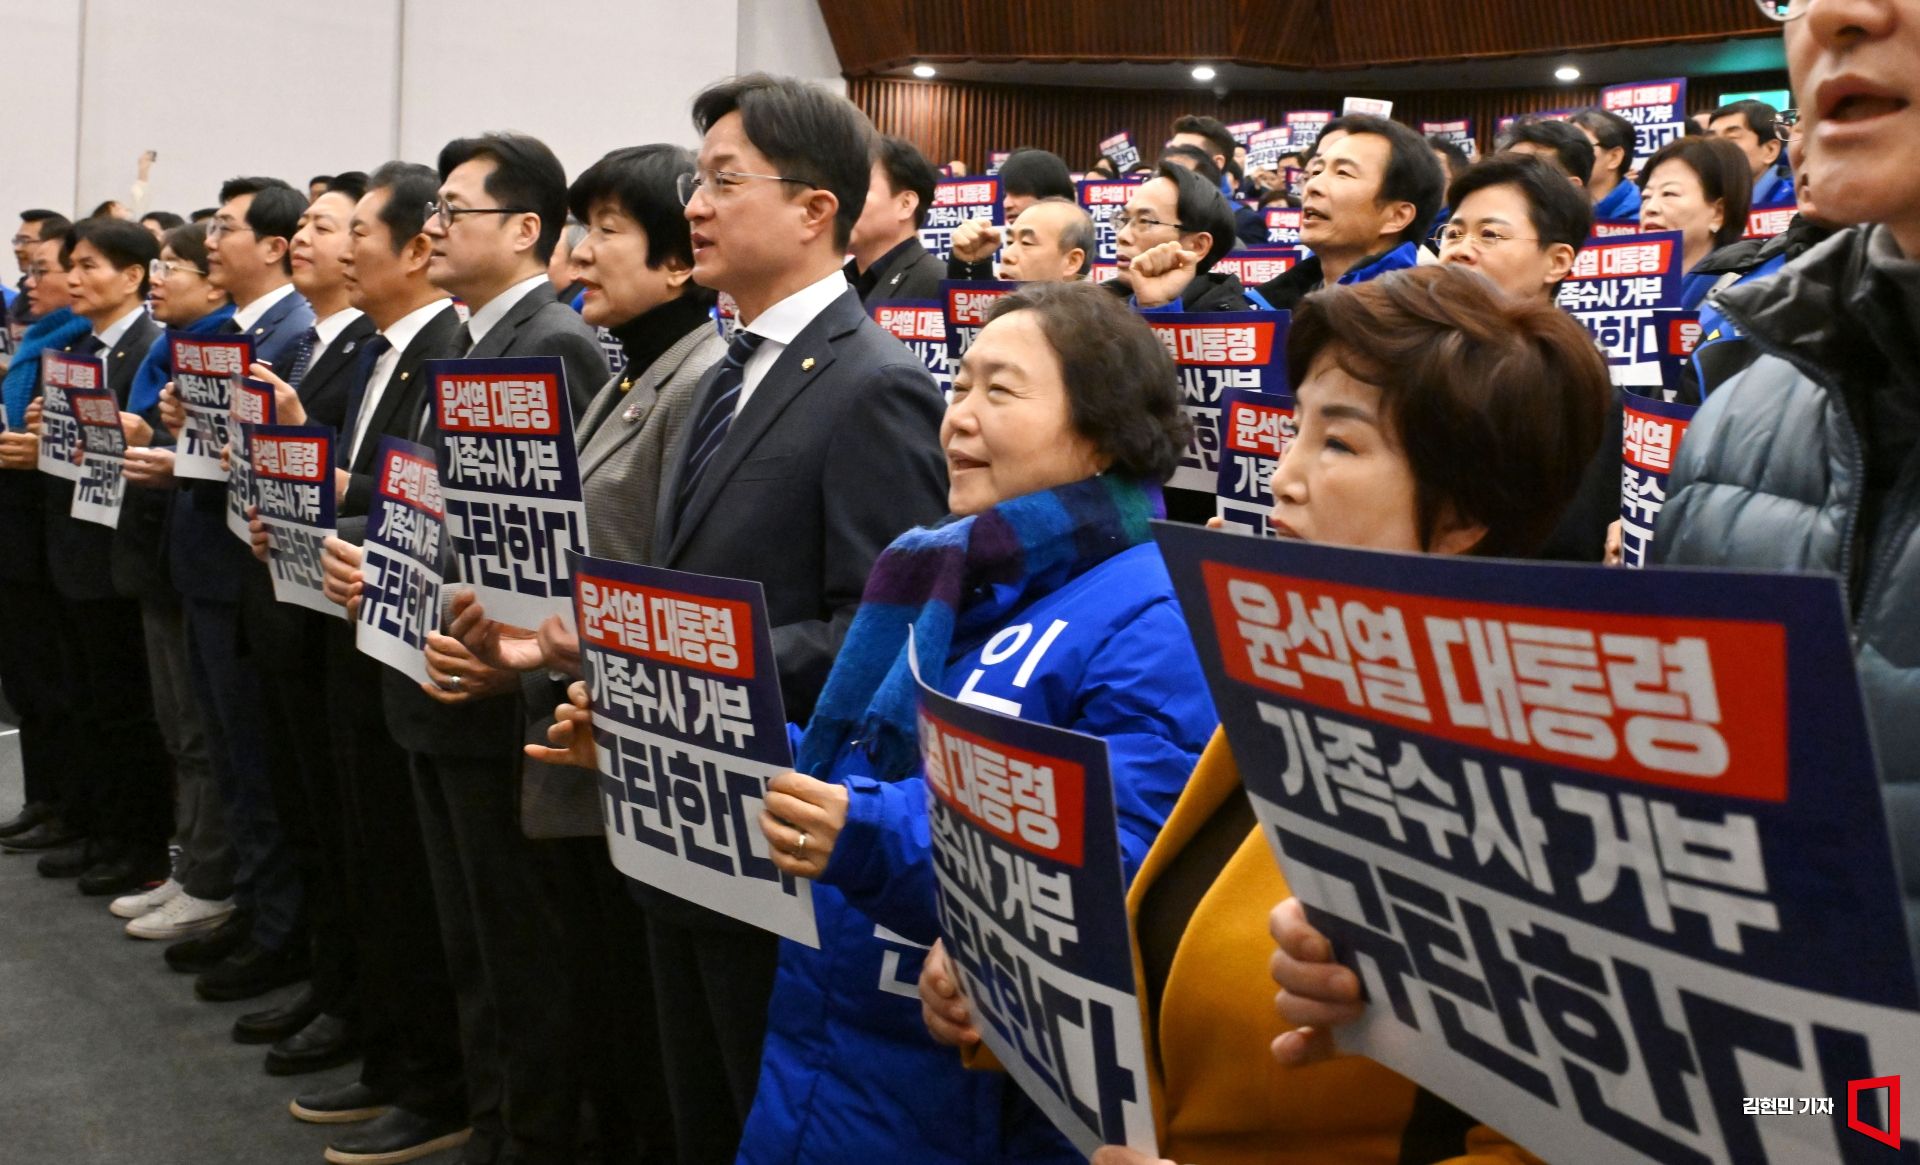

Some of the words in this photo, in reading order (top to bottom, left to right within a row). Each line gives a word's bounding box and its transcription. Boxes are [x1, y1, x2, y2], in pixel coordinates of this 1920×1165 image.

[1601, 244, 1661, 275] 대통령
[1557, 279, 1619, 310] 족수사
[1620, 276, 1662, 307] 거부
[916, 310, 947, 338] 대통
[1179, 326, 1257, 363] 대통령
[441, 380, 491, 428] 윤석열
[489, 380, 551, 430] 대통령
[279, 440, 319, 478] 대통령
[444, 436, 516, 489] 가족수사
[516, 439, 562, 492] 거부
[1623, 410, 1673, 469] 석열
[293, 483, 321, 522] 거부
[386, 454, 422, 504] 윤석열
[580, 580, 650, 651] 윤석열
[649, 596, 739, 670] 대통령
[586, 649, 687, 735] 가족수사
[692, 676, 756, 750] 거부
[1227, 578, 1433, 722] 윤석열
[1423, 616, 1731, 778] 대통령
[942, 731, 1061, 850] 대통령
[1254, 700, 1557, 896] 가족수사
[1551, 781, 1781, 955] 거부
[990, 843, 1079, 957] 거부
